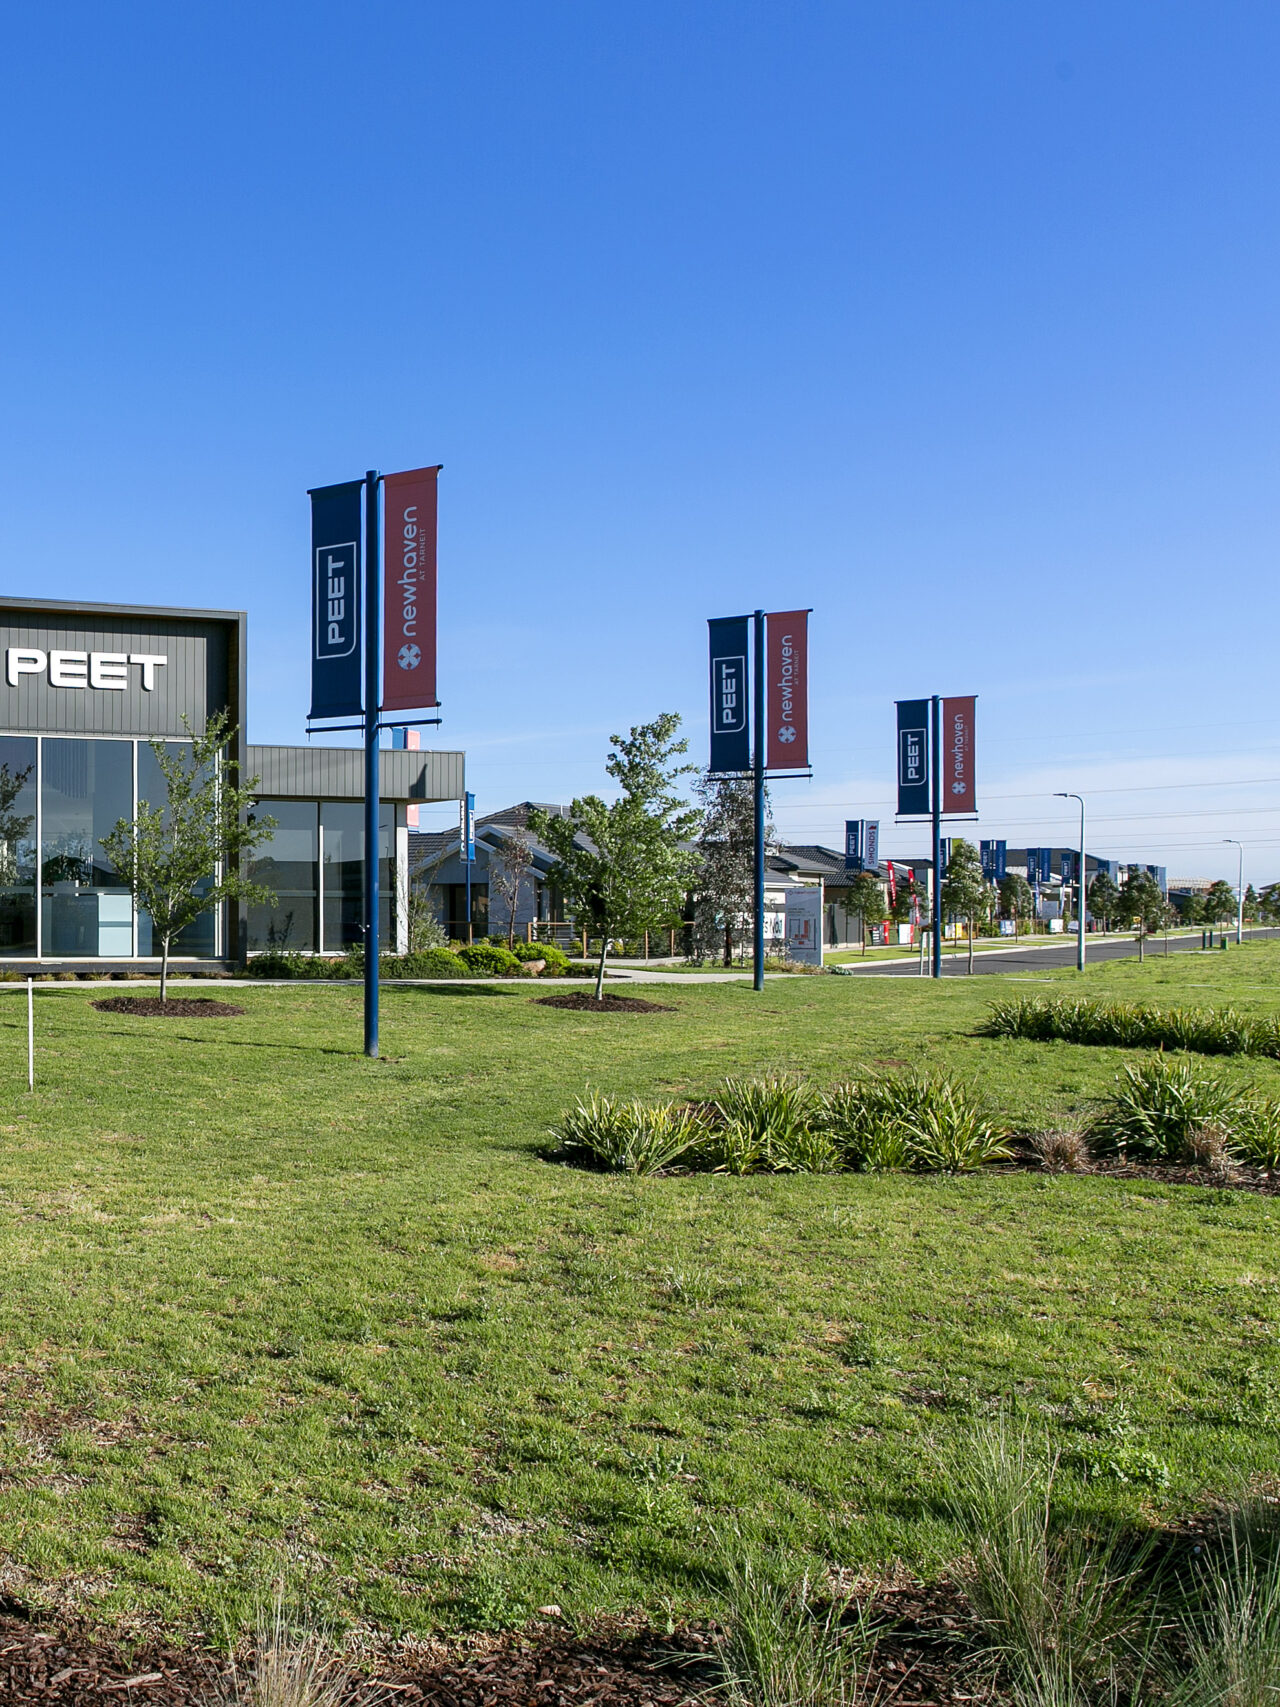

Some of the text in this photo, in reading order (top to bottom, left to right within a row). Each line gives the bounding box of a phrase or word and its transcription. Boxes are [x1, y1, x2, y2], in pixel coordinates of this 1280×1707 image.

[327, 555, 345, 645] PEET
[396, 505, 418, 637] newhaven
[6, 648, 168, 691] PEET
[722, 664, 737, 724] PEET
[777, 634, 793, 722] newhaven
[907, 733, 919, 779] PEET
[951, 713, 964, 779] newhaven
[868, 831, 876, 865] SIMONDS
